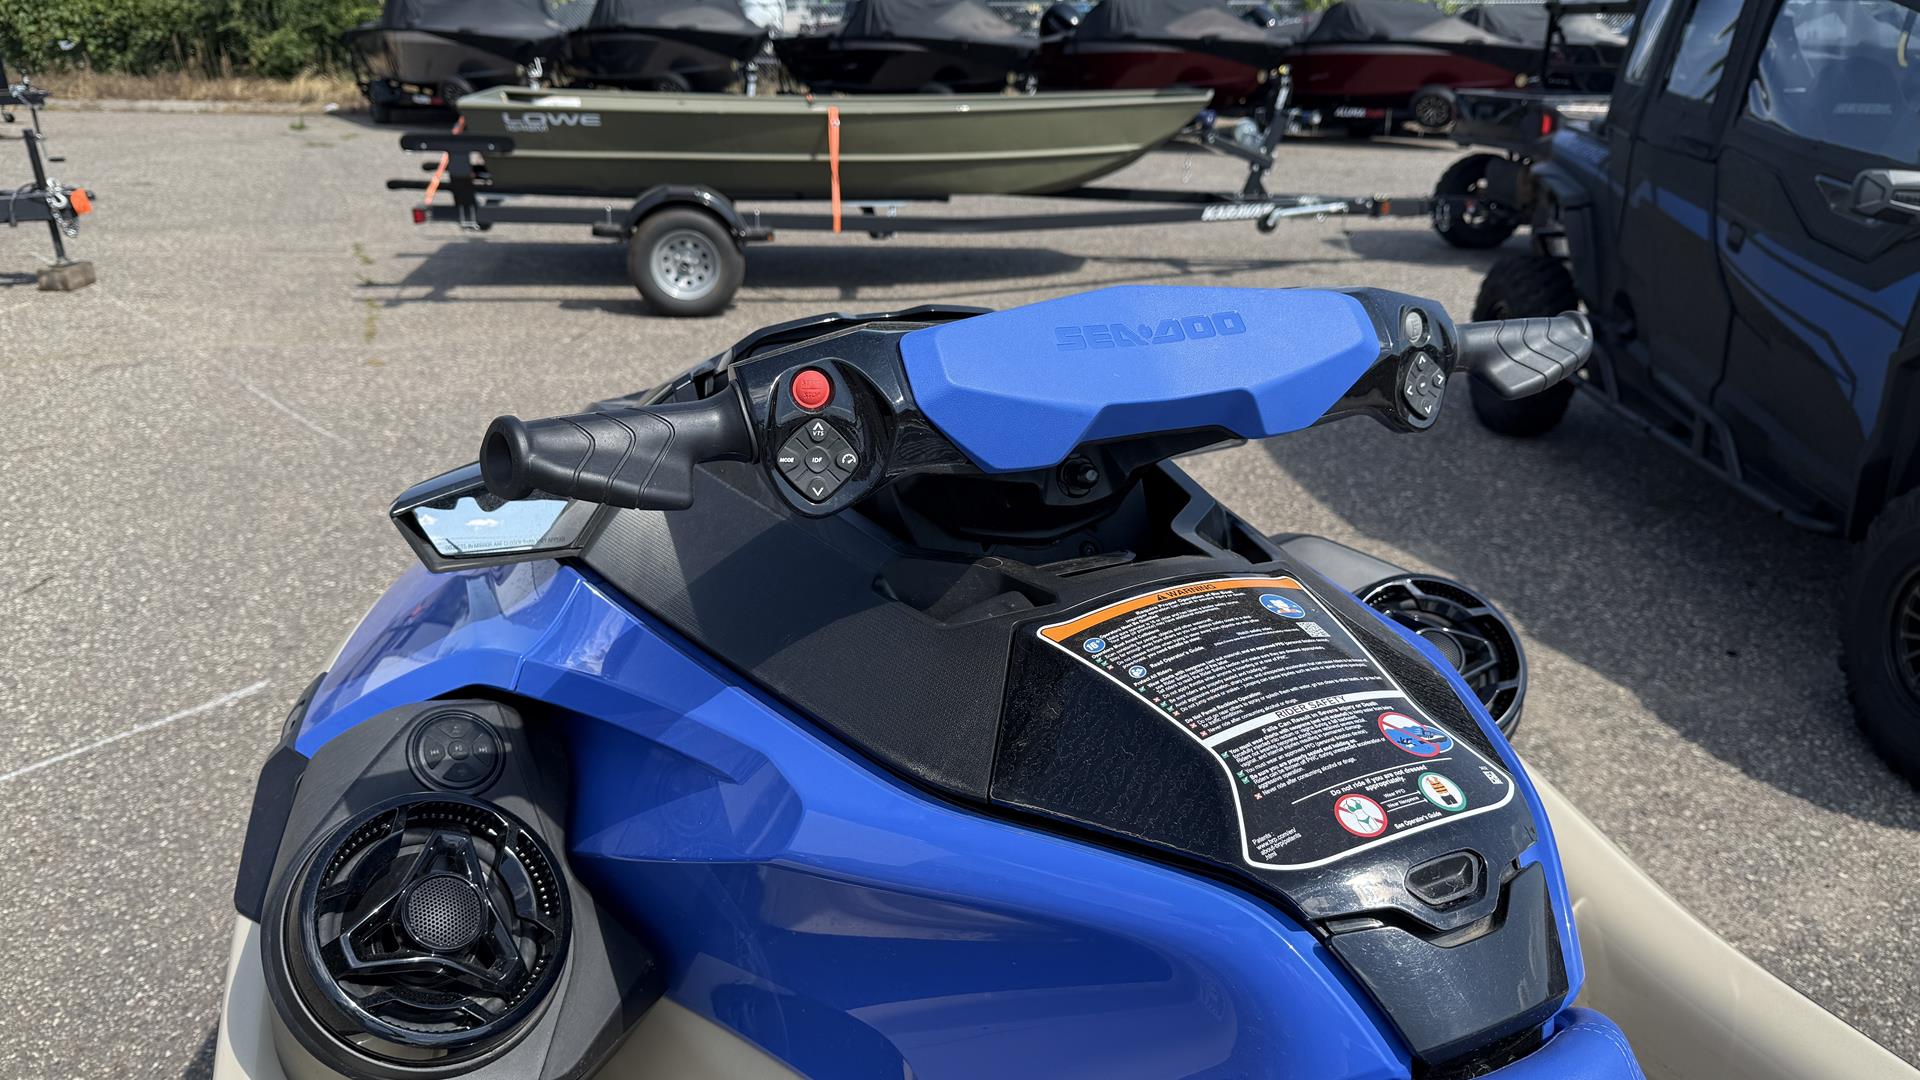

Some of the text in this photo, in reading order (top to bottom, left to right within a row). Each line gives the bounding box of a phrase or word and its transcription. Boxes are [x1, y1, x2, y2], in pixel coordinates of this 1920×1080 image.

[502, 112, 602, 127] LOWE
[1166, 584, 1216, 597] WARNING
[1275, 696, 1347, 718] RIDER SAFETY
[1290, 714, 1312, 723] Result
[1404, 765, 1427, 773] dressed
[1404, 815, 1428, 826] Operator's
[1252, 833, 1272, 846] Patents
